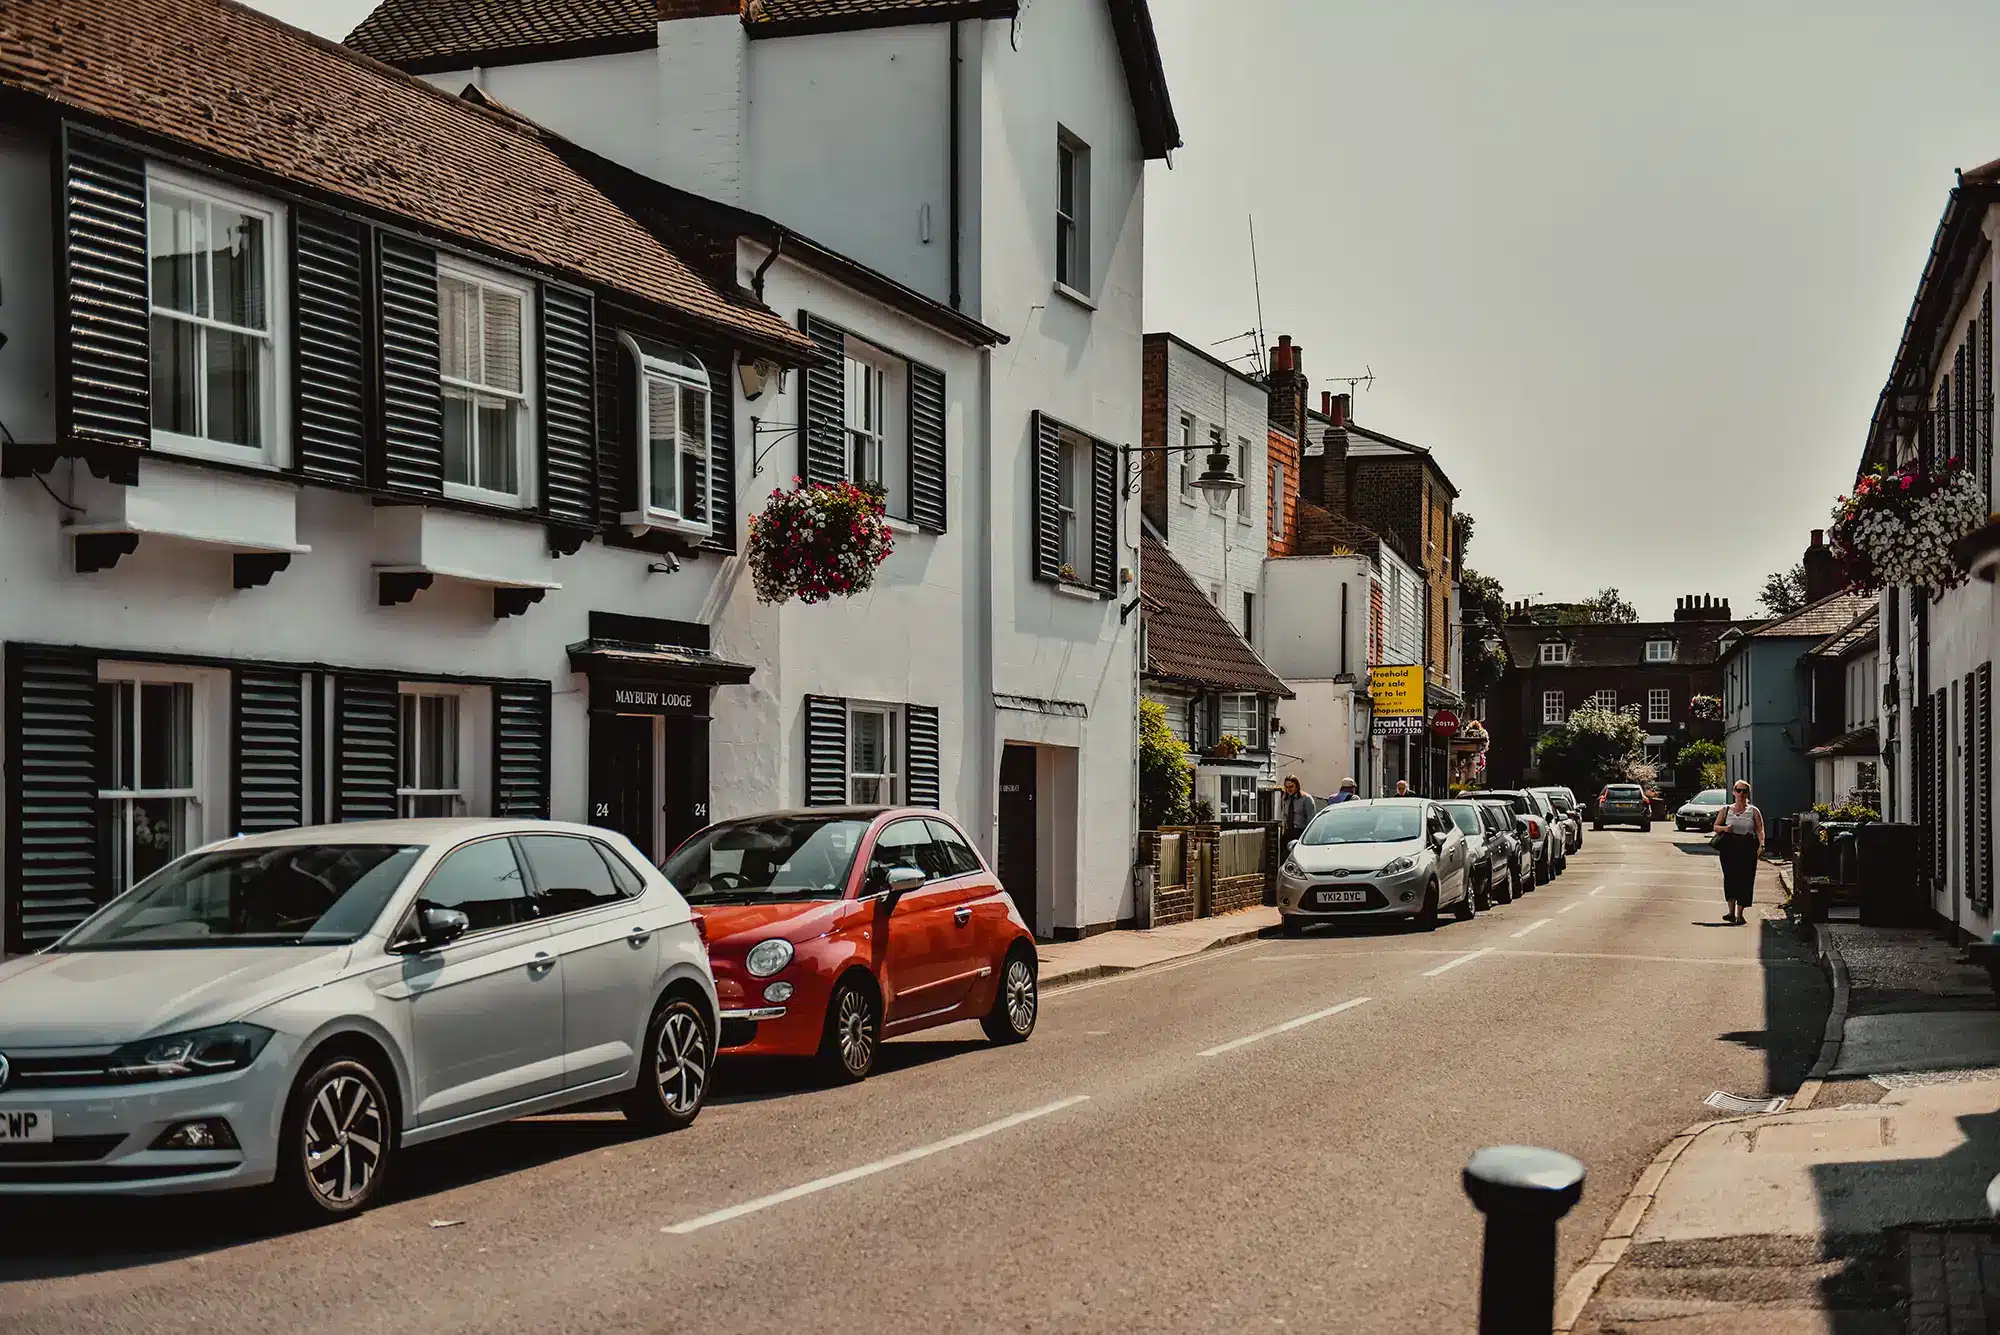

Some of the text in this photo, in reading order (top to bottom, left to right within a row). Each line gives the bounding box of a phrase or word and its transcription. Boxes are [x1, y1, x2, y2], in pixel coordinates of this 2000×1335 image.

[615, 690, 692, 707] MAYBURY LODGE
[1373, 717, 1422, 728] franklin
[596, 803, 609, 817] 24
[695, 803, 707, 817] 24
[1322, 892, 1342, 901] YK12
